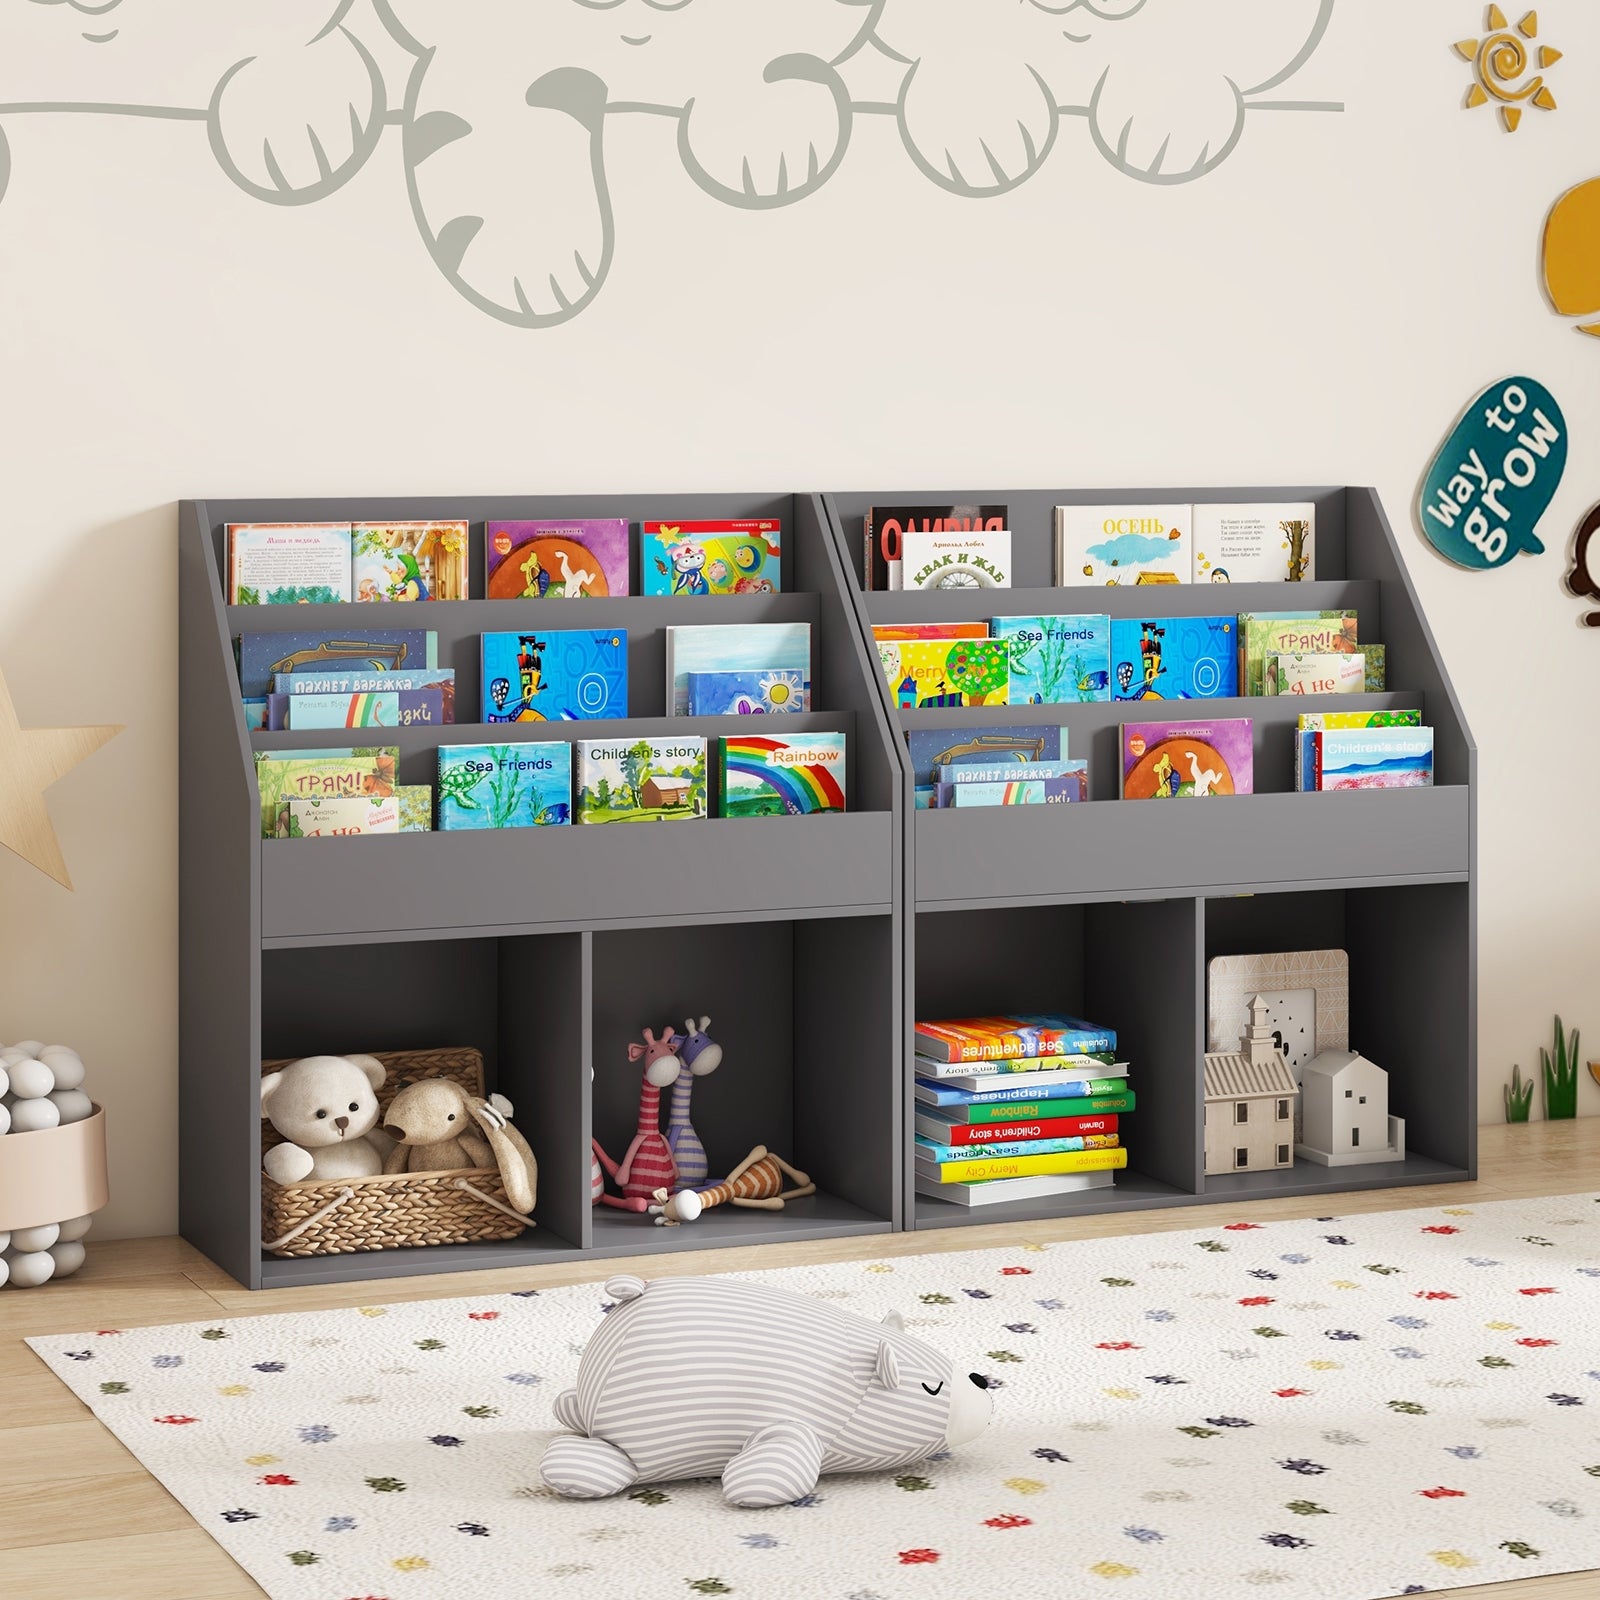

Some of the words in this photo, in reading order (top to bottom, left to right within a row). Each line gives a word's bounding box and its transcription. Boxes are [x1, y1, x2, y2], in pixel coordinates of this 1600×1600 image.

[1427, 448, 1488, 528] way
[1485, 385, 1527, 433] to
[1463, 408, 1560, 562] grow
[1103, 518, 1164, 535] ОСЕНЬ
[913, 553, 953, 586] КВАК
[957, 553, 969, 563] И
[971, 555, 1005, 583] ЖАБ
[1018, 630, 1043, 642] Sea
[1047, 629, 1094, 640] Friends
[1278, 631, 1330, 650] ТРЯМ!
[900, 665, 947, 681] Merry
[1312, 679, 1335, 693] не
[591, 747, 661, 760] Children's
[666, 746, 700, 759] story
[1327, 742, 1392, 755] Children's
[1396, 741, 1427, 754] story
[773, 750, 839, 763] Rainbow
[465, 760, 493, 772] Sea
[499, 758, 553, 771] Friends
[296, 771, 361, 792] ТРЯМ!
[962, 1042, 1036, 1057] adventures
[1038, 1040, 1064, 1052] Sea
[1072, 1039, 1108, 1048] Louisiana
[945, 1067, 970, 1076] story
[972, 1090, 1049, 1101] Happiness
[1092, 1100, 1127, 1108] Columbia
[990, 1105, 1039, 1117] Rainbow
[994, 1127, 1041, 1137] Children's
[1079, 1121, 1105, 1130] Darwin
[969, 1129, 992, 1139] story
[1076, 1155, 1121, 1166] Mississippi
[965, 1166, 986, 1177] City
[989, 1164, 1019, 1176] Merry
